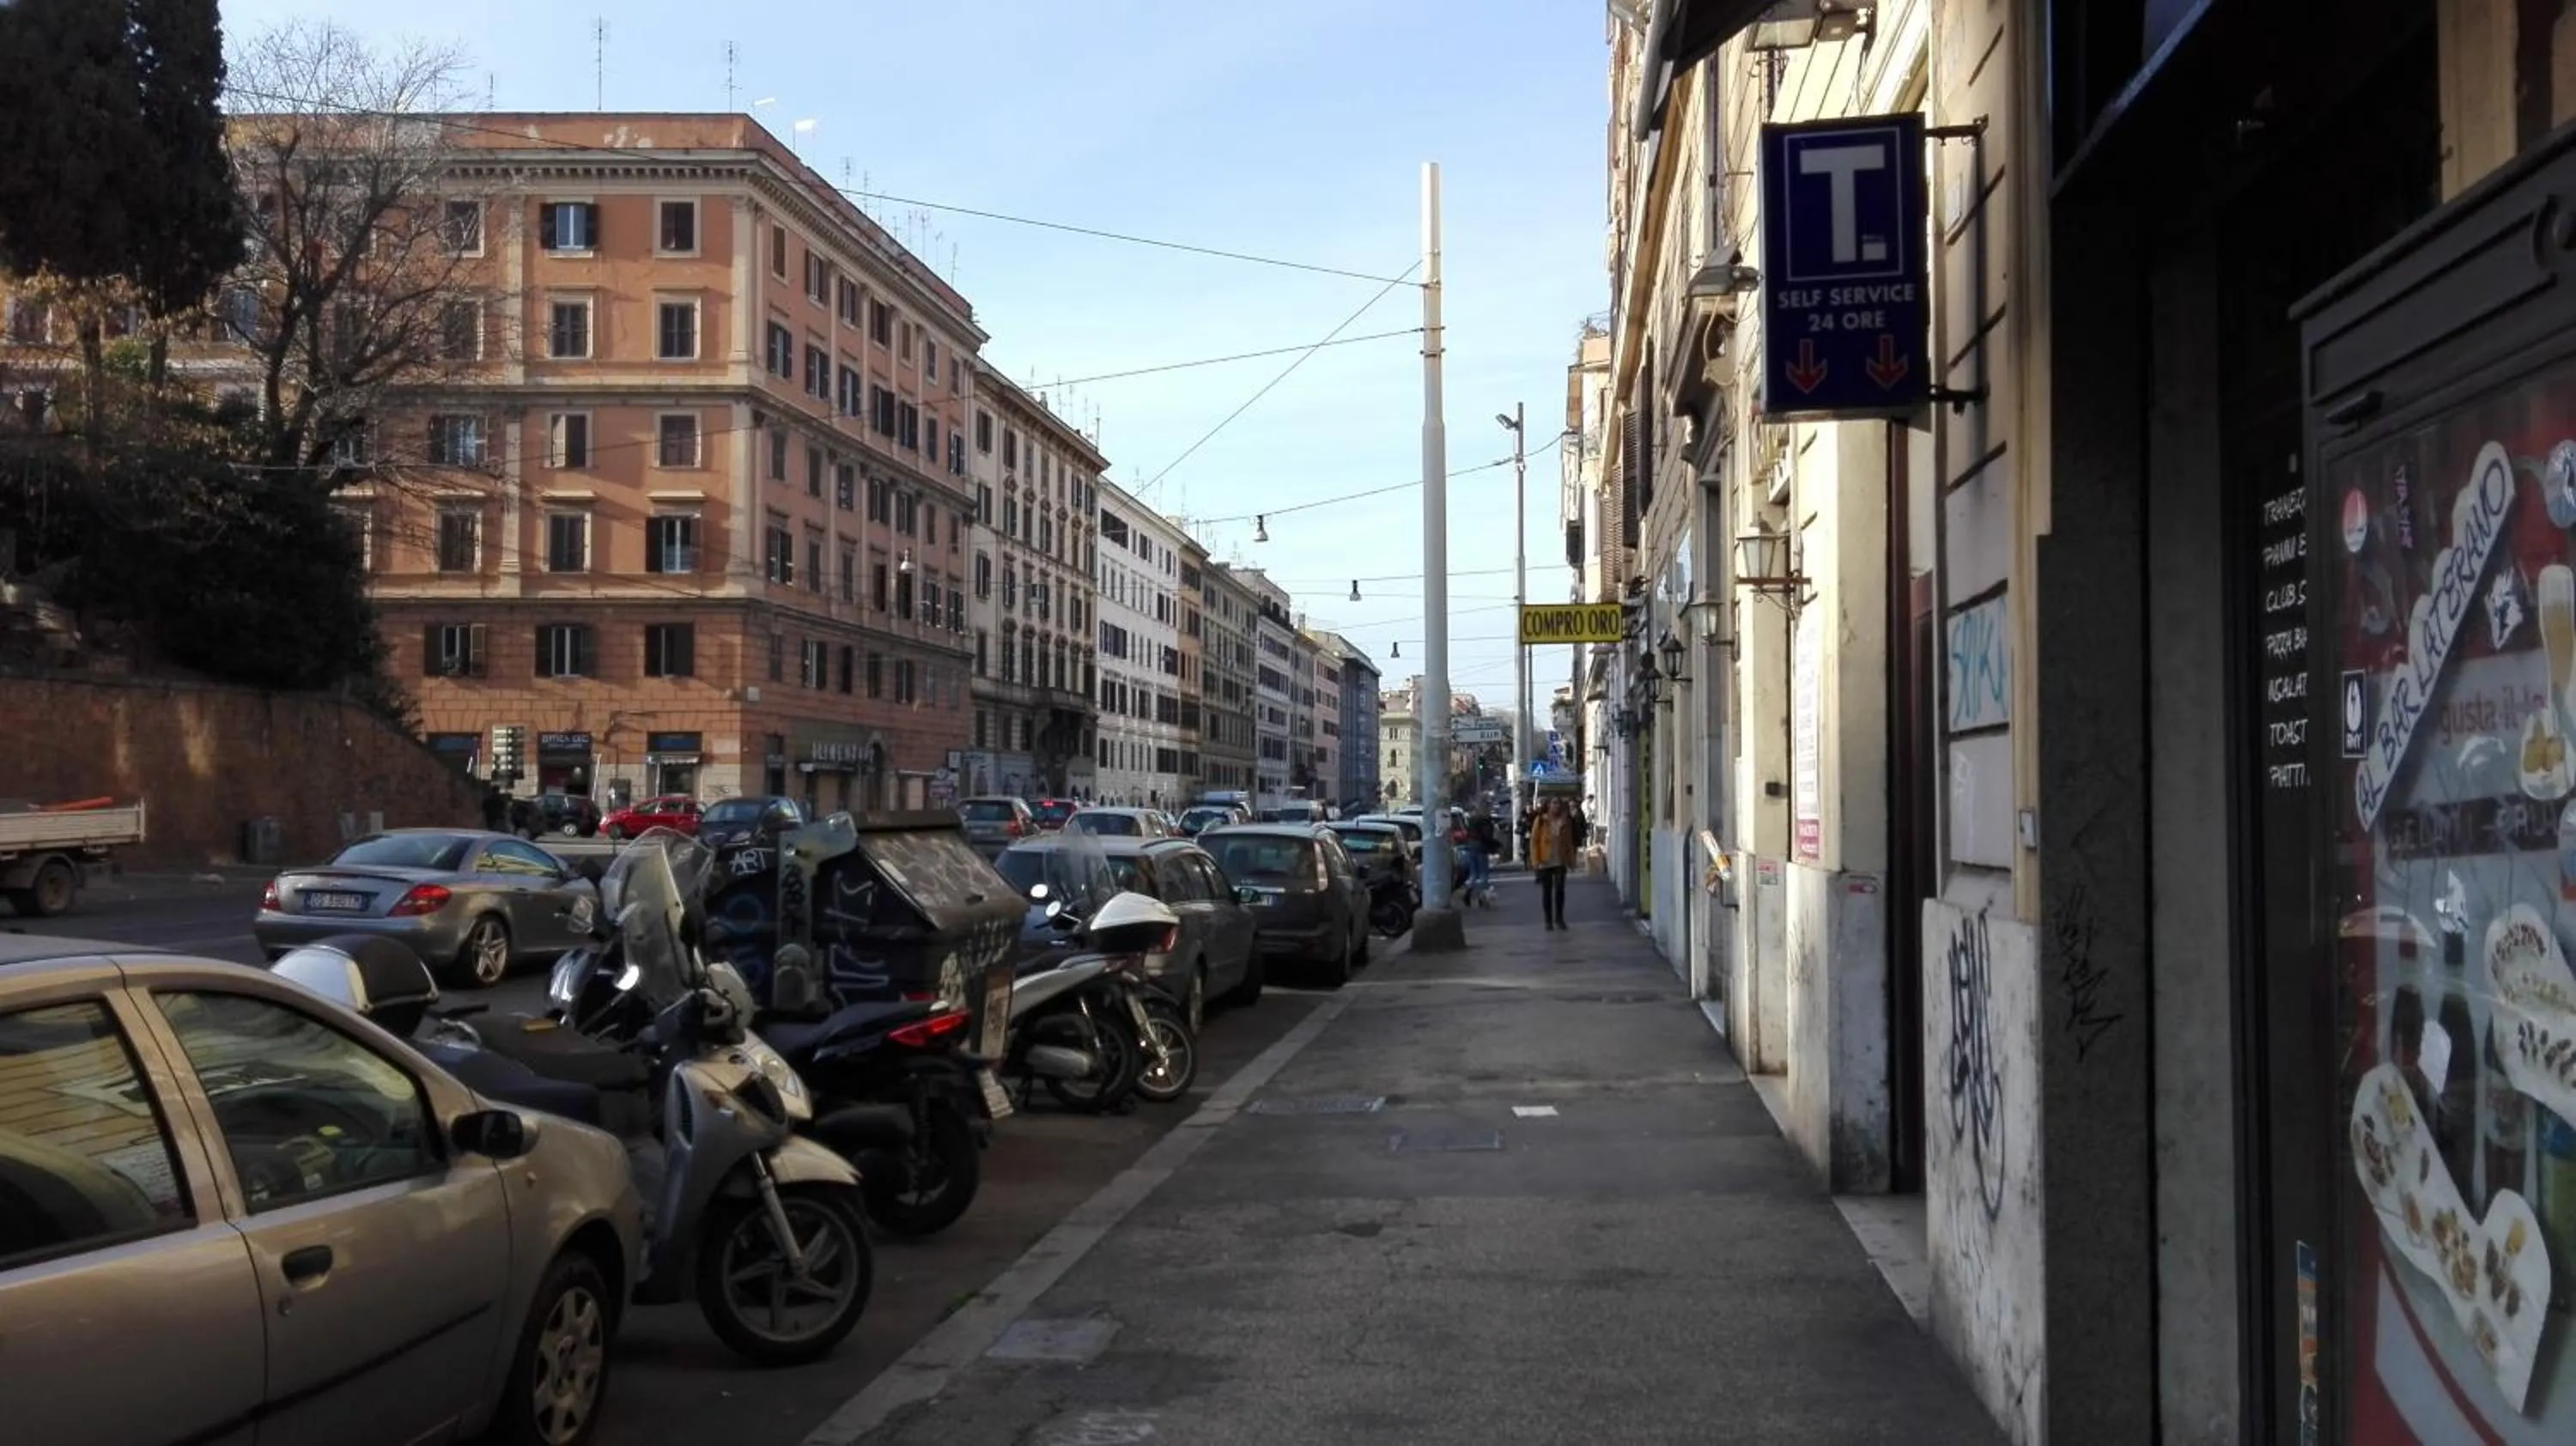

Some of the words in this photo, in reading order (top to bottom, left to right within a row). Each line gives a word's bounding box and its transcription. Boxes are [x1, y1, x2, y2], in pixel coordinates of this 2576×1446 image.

[1777, 289, 1823, 308] SELF
[1831, 283, 1915, 305] SERVICE
[1808, 313, 1835, 332] 24
[1842, 310, 1886, 330] ORE
[1523, 611, 1584, 636] COMPRO
[1588, 609, 1619, 635] ORO
[2378, 677, 2420, 771] BAR
[2412, 459, 2506, 697] LATERANO
[2269, 718, 2308, 747] TOAST
